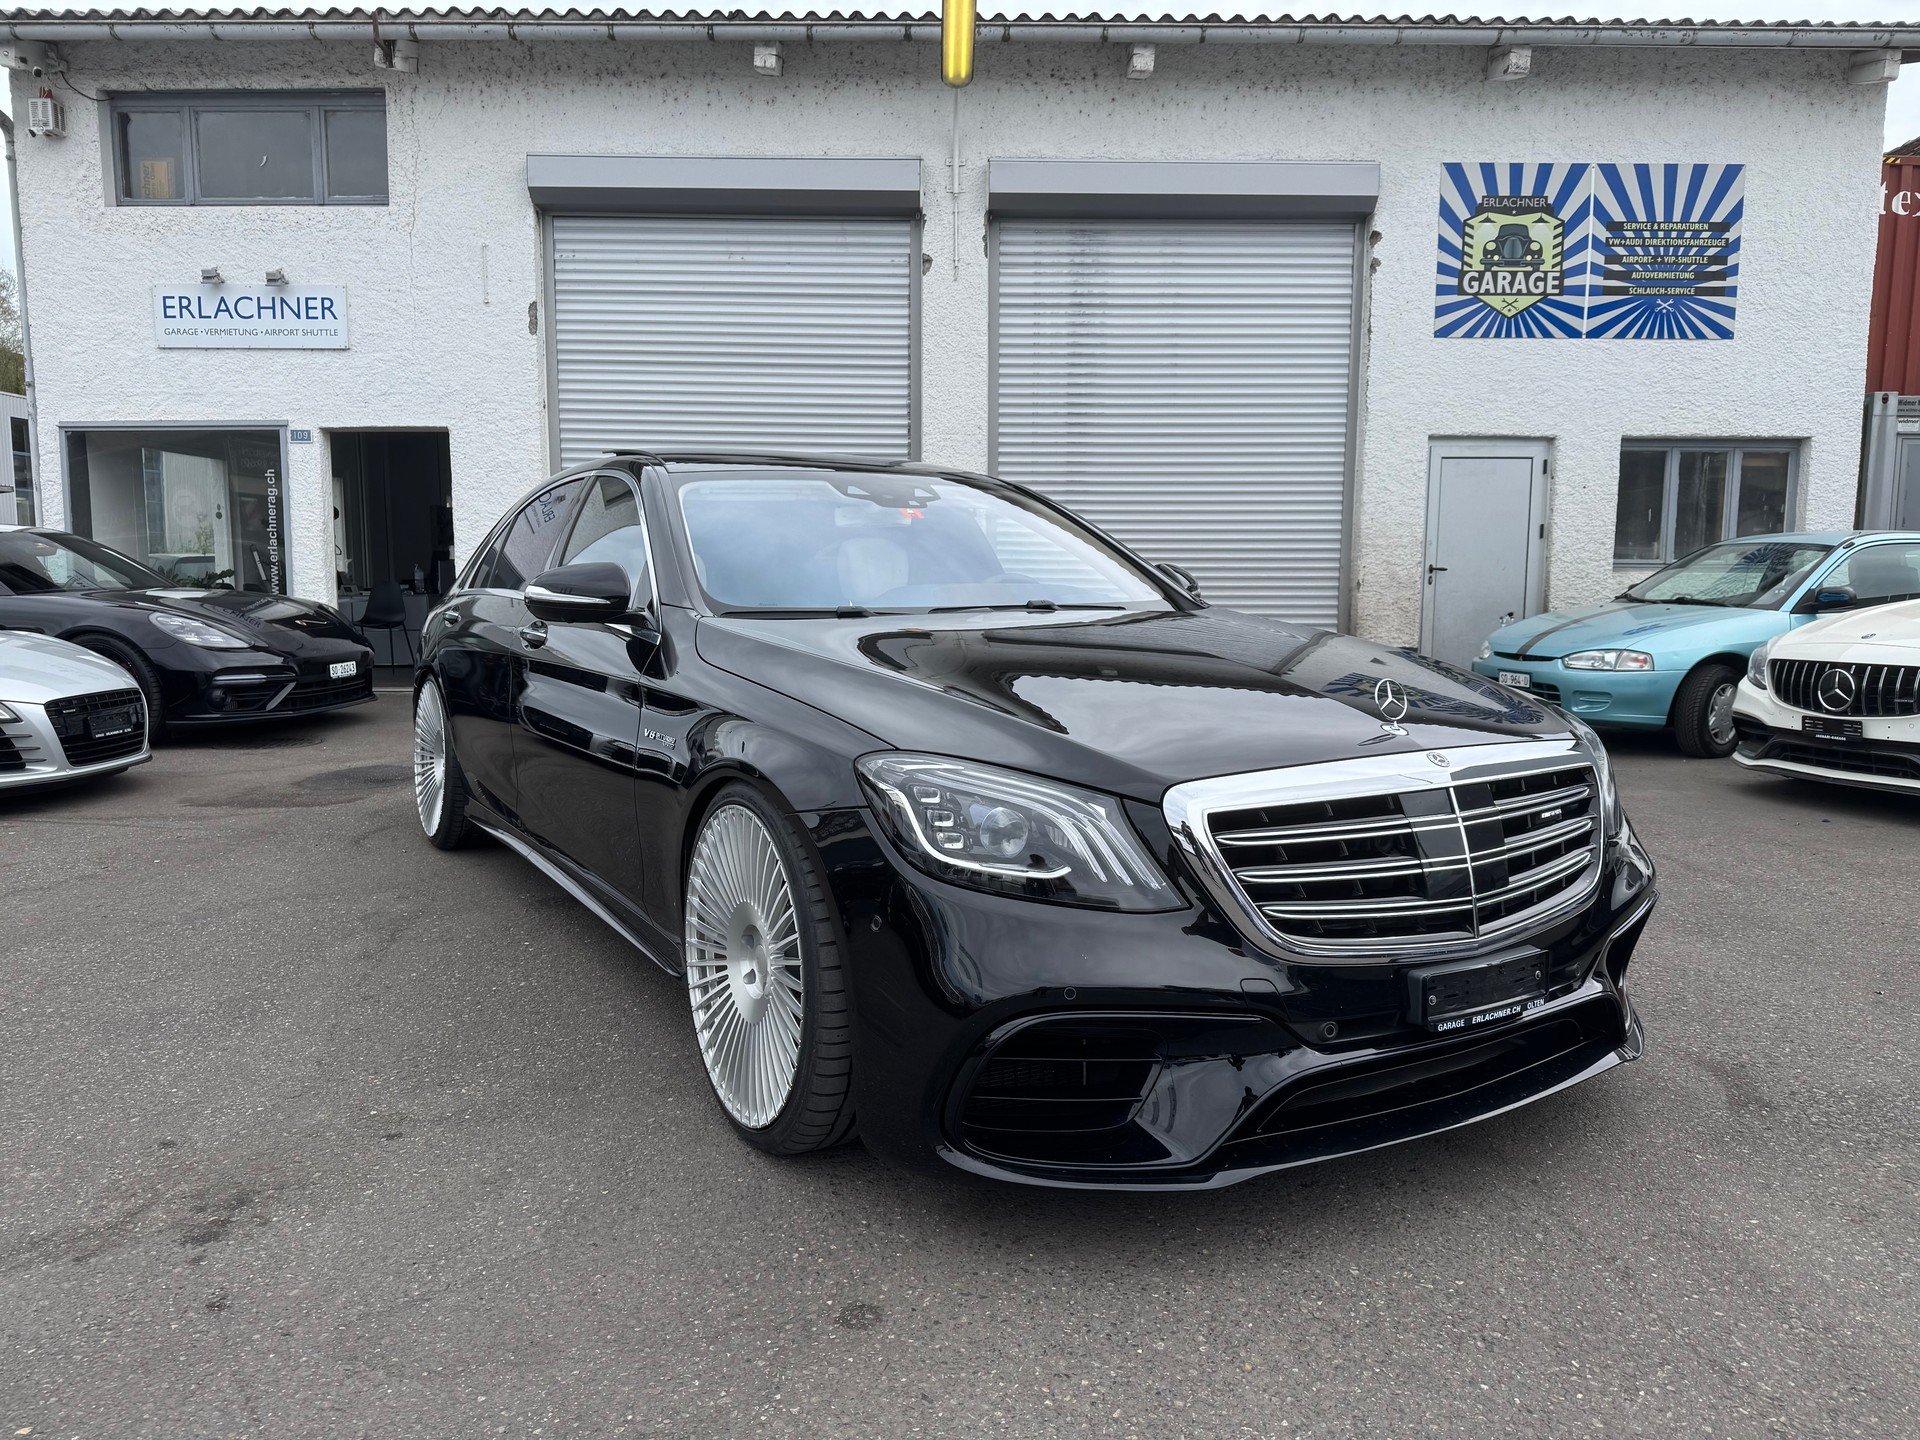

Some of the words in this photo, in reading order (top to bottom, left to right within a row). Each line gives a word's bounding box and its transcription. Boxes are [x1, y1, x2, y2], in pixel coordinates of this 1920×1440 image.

[1483, 198, 1547, 208] ERLACHNER
[1608, 238, 1642, 246] VW+AUDI
[1645, 238, 1726, 246] DIREKTIONSFAHRZEUGE
[1462, 271, 1561, 294] GARAGE
[1629, 287, 1695, 295] SCHLAUCH-SERVICE
[162, 295, 338, 320] ERLACHNER
[164, 327, 199, 336] GARAGE
[204, 328, 259, 337] VERMIETUNG
[264, 329, 299, 337] AIRPORT
[301, 329, 339, 337] SHUTTLE
[293, 431, 308, 440] 109
[265, 468, 279, 596] www.erlachnerag.ch
[644, 728, 656, 739] V8
[1437, 1018, 1465, 1032] GARAGE
[1472, 1005, 1521, 1024] ERLACHNER.CH
[1527, 999, 1545, 1010] OLTEN
